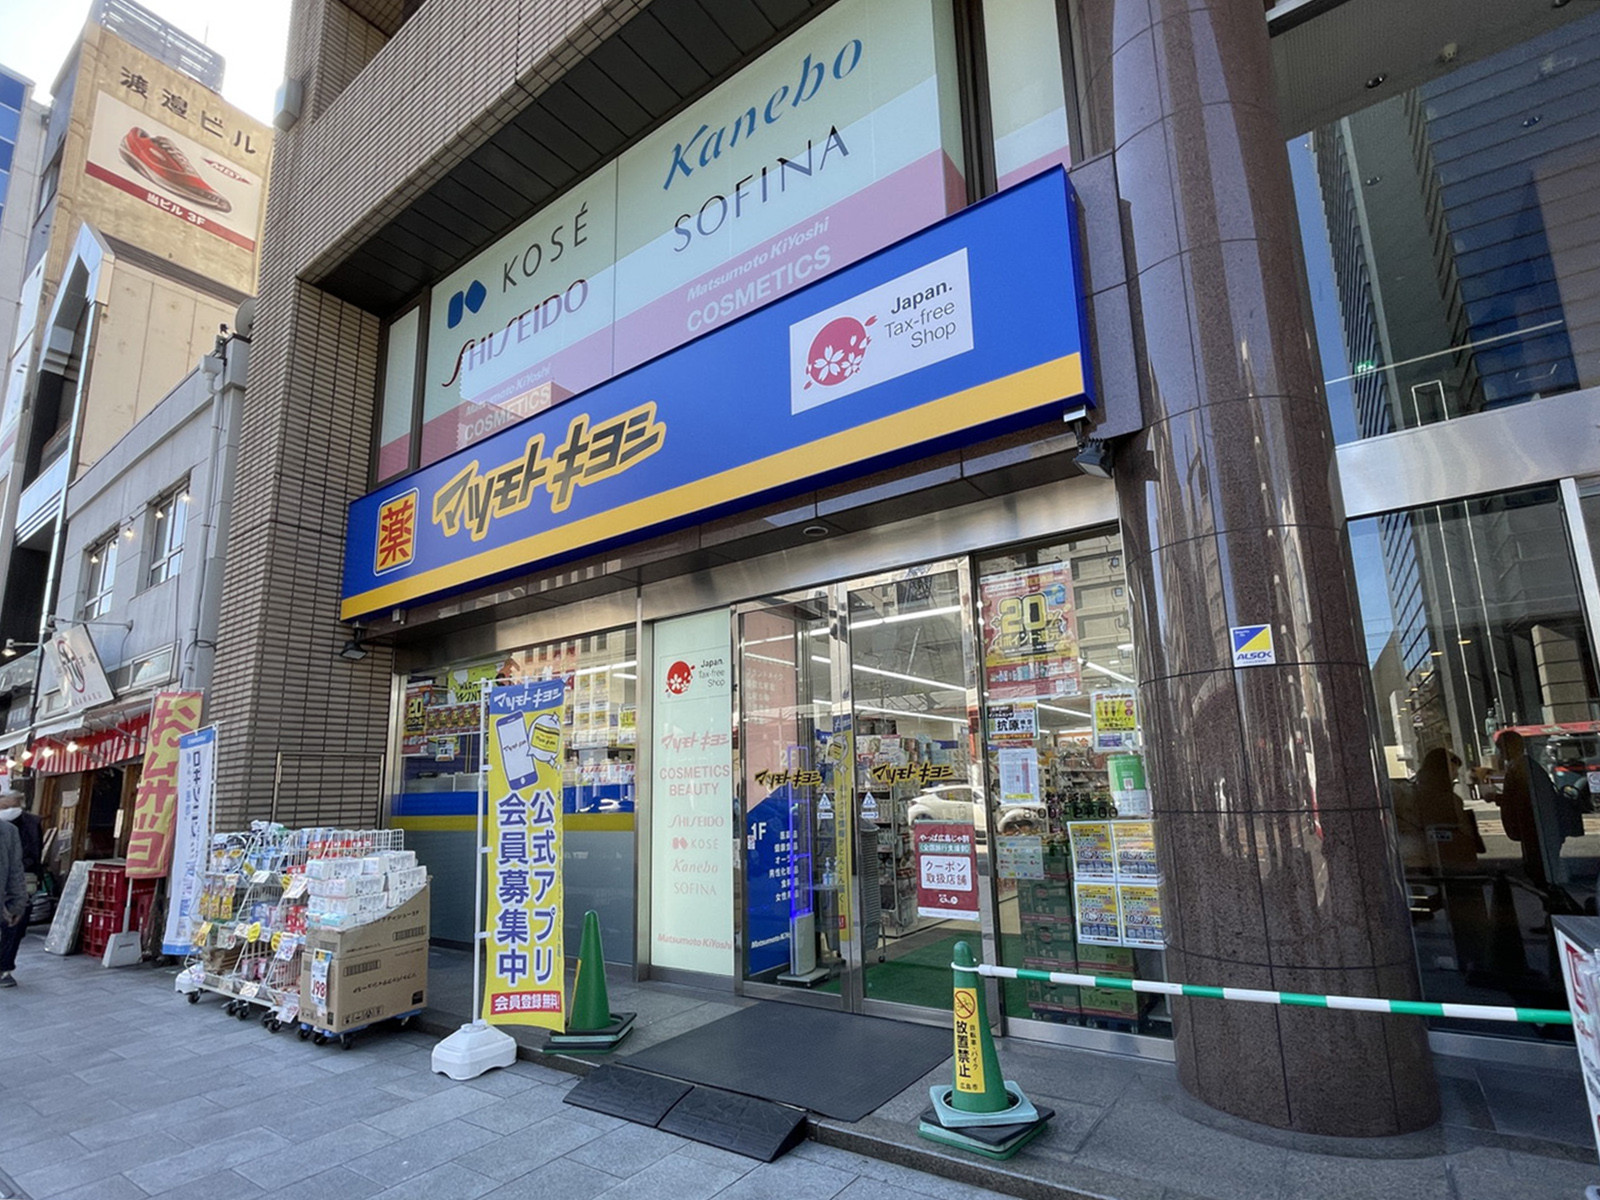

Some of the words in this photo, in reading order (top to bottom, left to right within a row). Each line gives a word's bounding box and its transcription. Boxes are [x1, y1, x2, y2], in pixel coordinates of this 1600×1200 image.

[663, 39, 862, 190] Kanebo
[673, 125, 849, 252] SOFINA
[146, 191, 183, 216] 当ビル
[187, 212, 206, 226] 3F
[502, 201, 589, 293] KOSÉ
[687, 251, 769, 303] Matsumoto
[770, 216, 830, 262] KiYoshi
[687, 244, 831, 332] COSMETICS
[890, 280, 953, 315] Japan.
[885, 300, 956, 339] Tax-free
[441, 278, 589, 387] SHISEIDO
[911, 321, 956, 351] Shop
[464, 386, 551, 441] COSMETICS
[433, 403, 665, 541] マツモトキヨシ
[379, 499, 414, 568] 薬
[1237, 651, 1272, 660] ALSOK
[698, 669, 725, 678] Tax-free
[707, 679, 725, 688] Shop
[493, 688, 562, 711] マツモトキヨシ
[661, 731, 730, 753] マツモトキヨシ
[659, 765, 730, 780] COSMETICS
[754, 769, 822, 788] マツモトキヨシ
[872, 763, 954, 784] マツモトキヨシ
[669, 783, 719, 797] BEAUTY
[667, 815, 724, 828] SHISEIDO
[751, 822, 767, 841] 1F
[672, 859, 718, 874] Kanebo
[925, 861, 967, 873] クーポン
[497, 793, 530, 984] 会員募集中
[530, 791, 556, 982] 公式アプリ
[673, 882, 717, 896] SOFINA
[926, 873, 968, 886] 取扱店舗
[657, 933, 702, 947] Matsumoto
[702, 938, 732, 950] KiYoshi
[311, 979, 326, 997] 198
[494, 993, 560, 1012] 会員登録無料
[956, 1020, 972, 1079] 放置禁止
